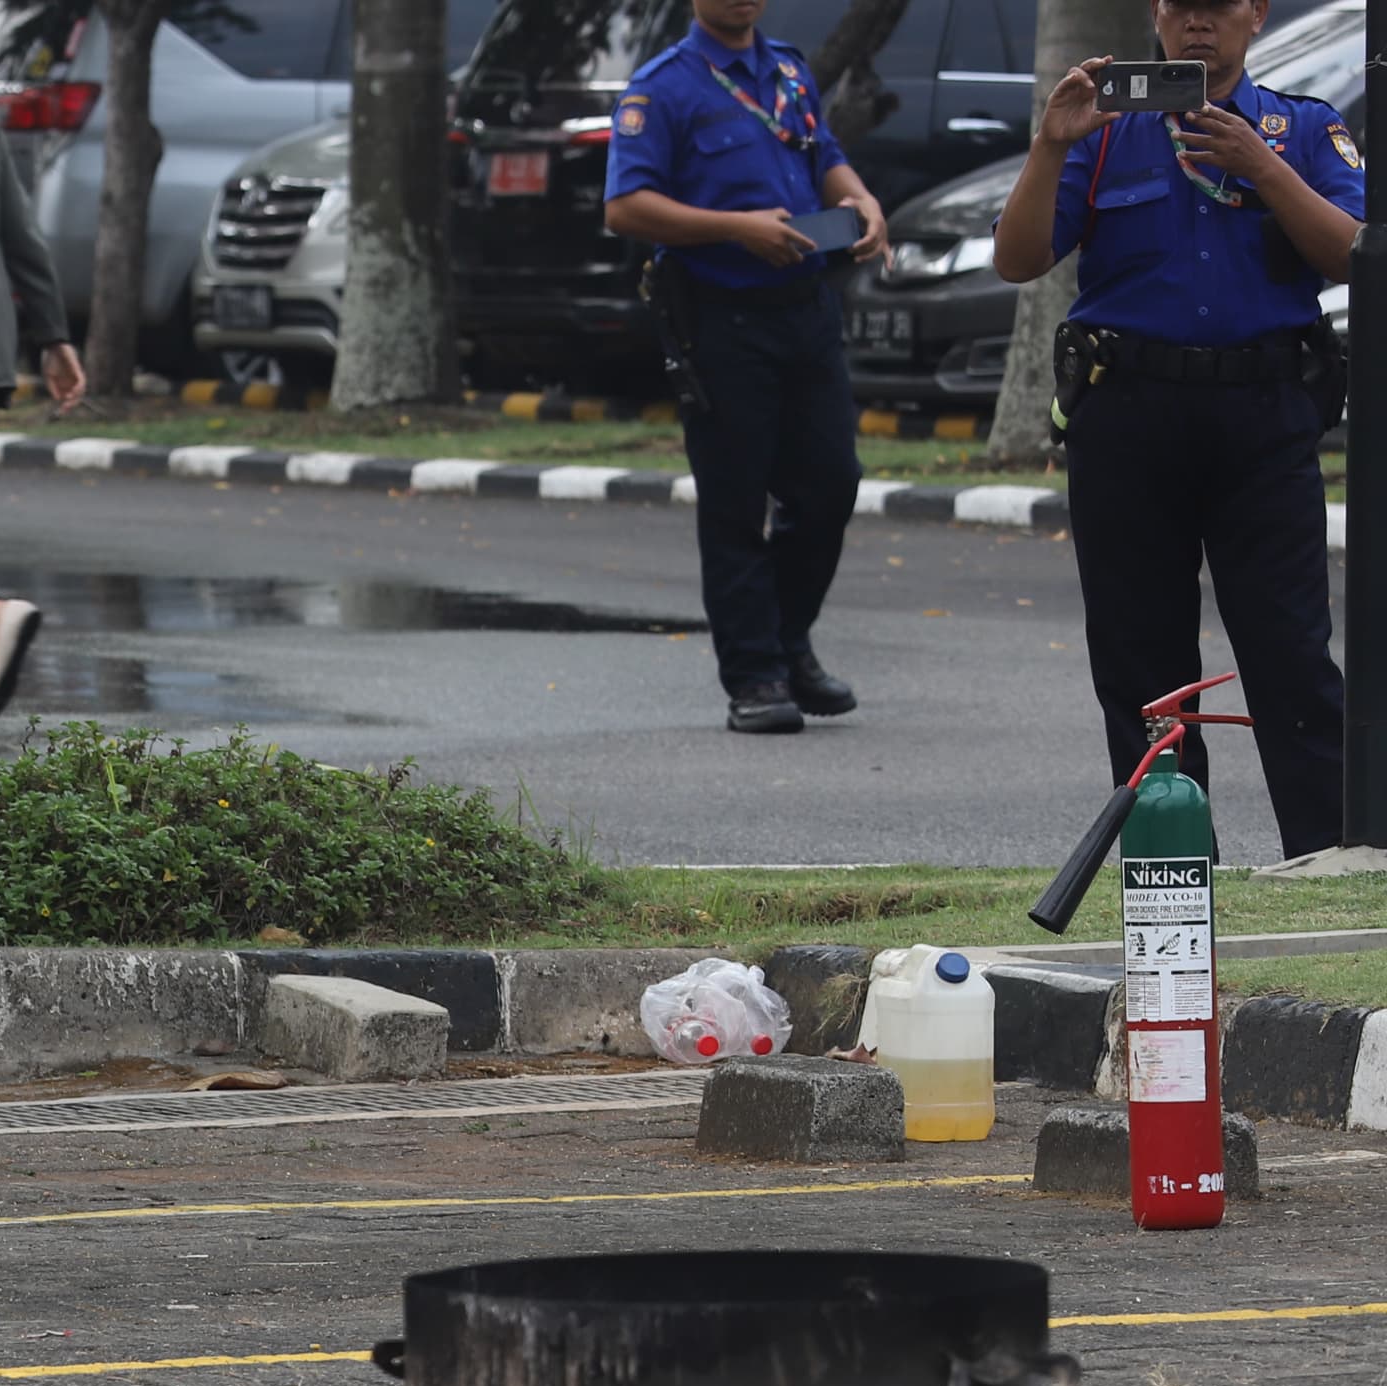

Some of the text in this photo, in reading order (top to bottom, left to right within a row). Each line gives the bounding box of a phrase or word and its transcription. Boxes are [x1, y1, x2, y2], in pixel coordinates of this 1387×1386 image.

[1131, 864, 1200, 886] VIKING
[1127, 891, 1203, 902] MODEL VCO-10
[1160, 904, 1172, 912] FIRE
